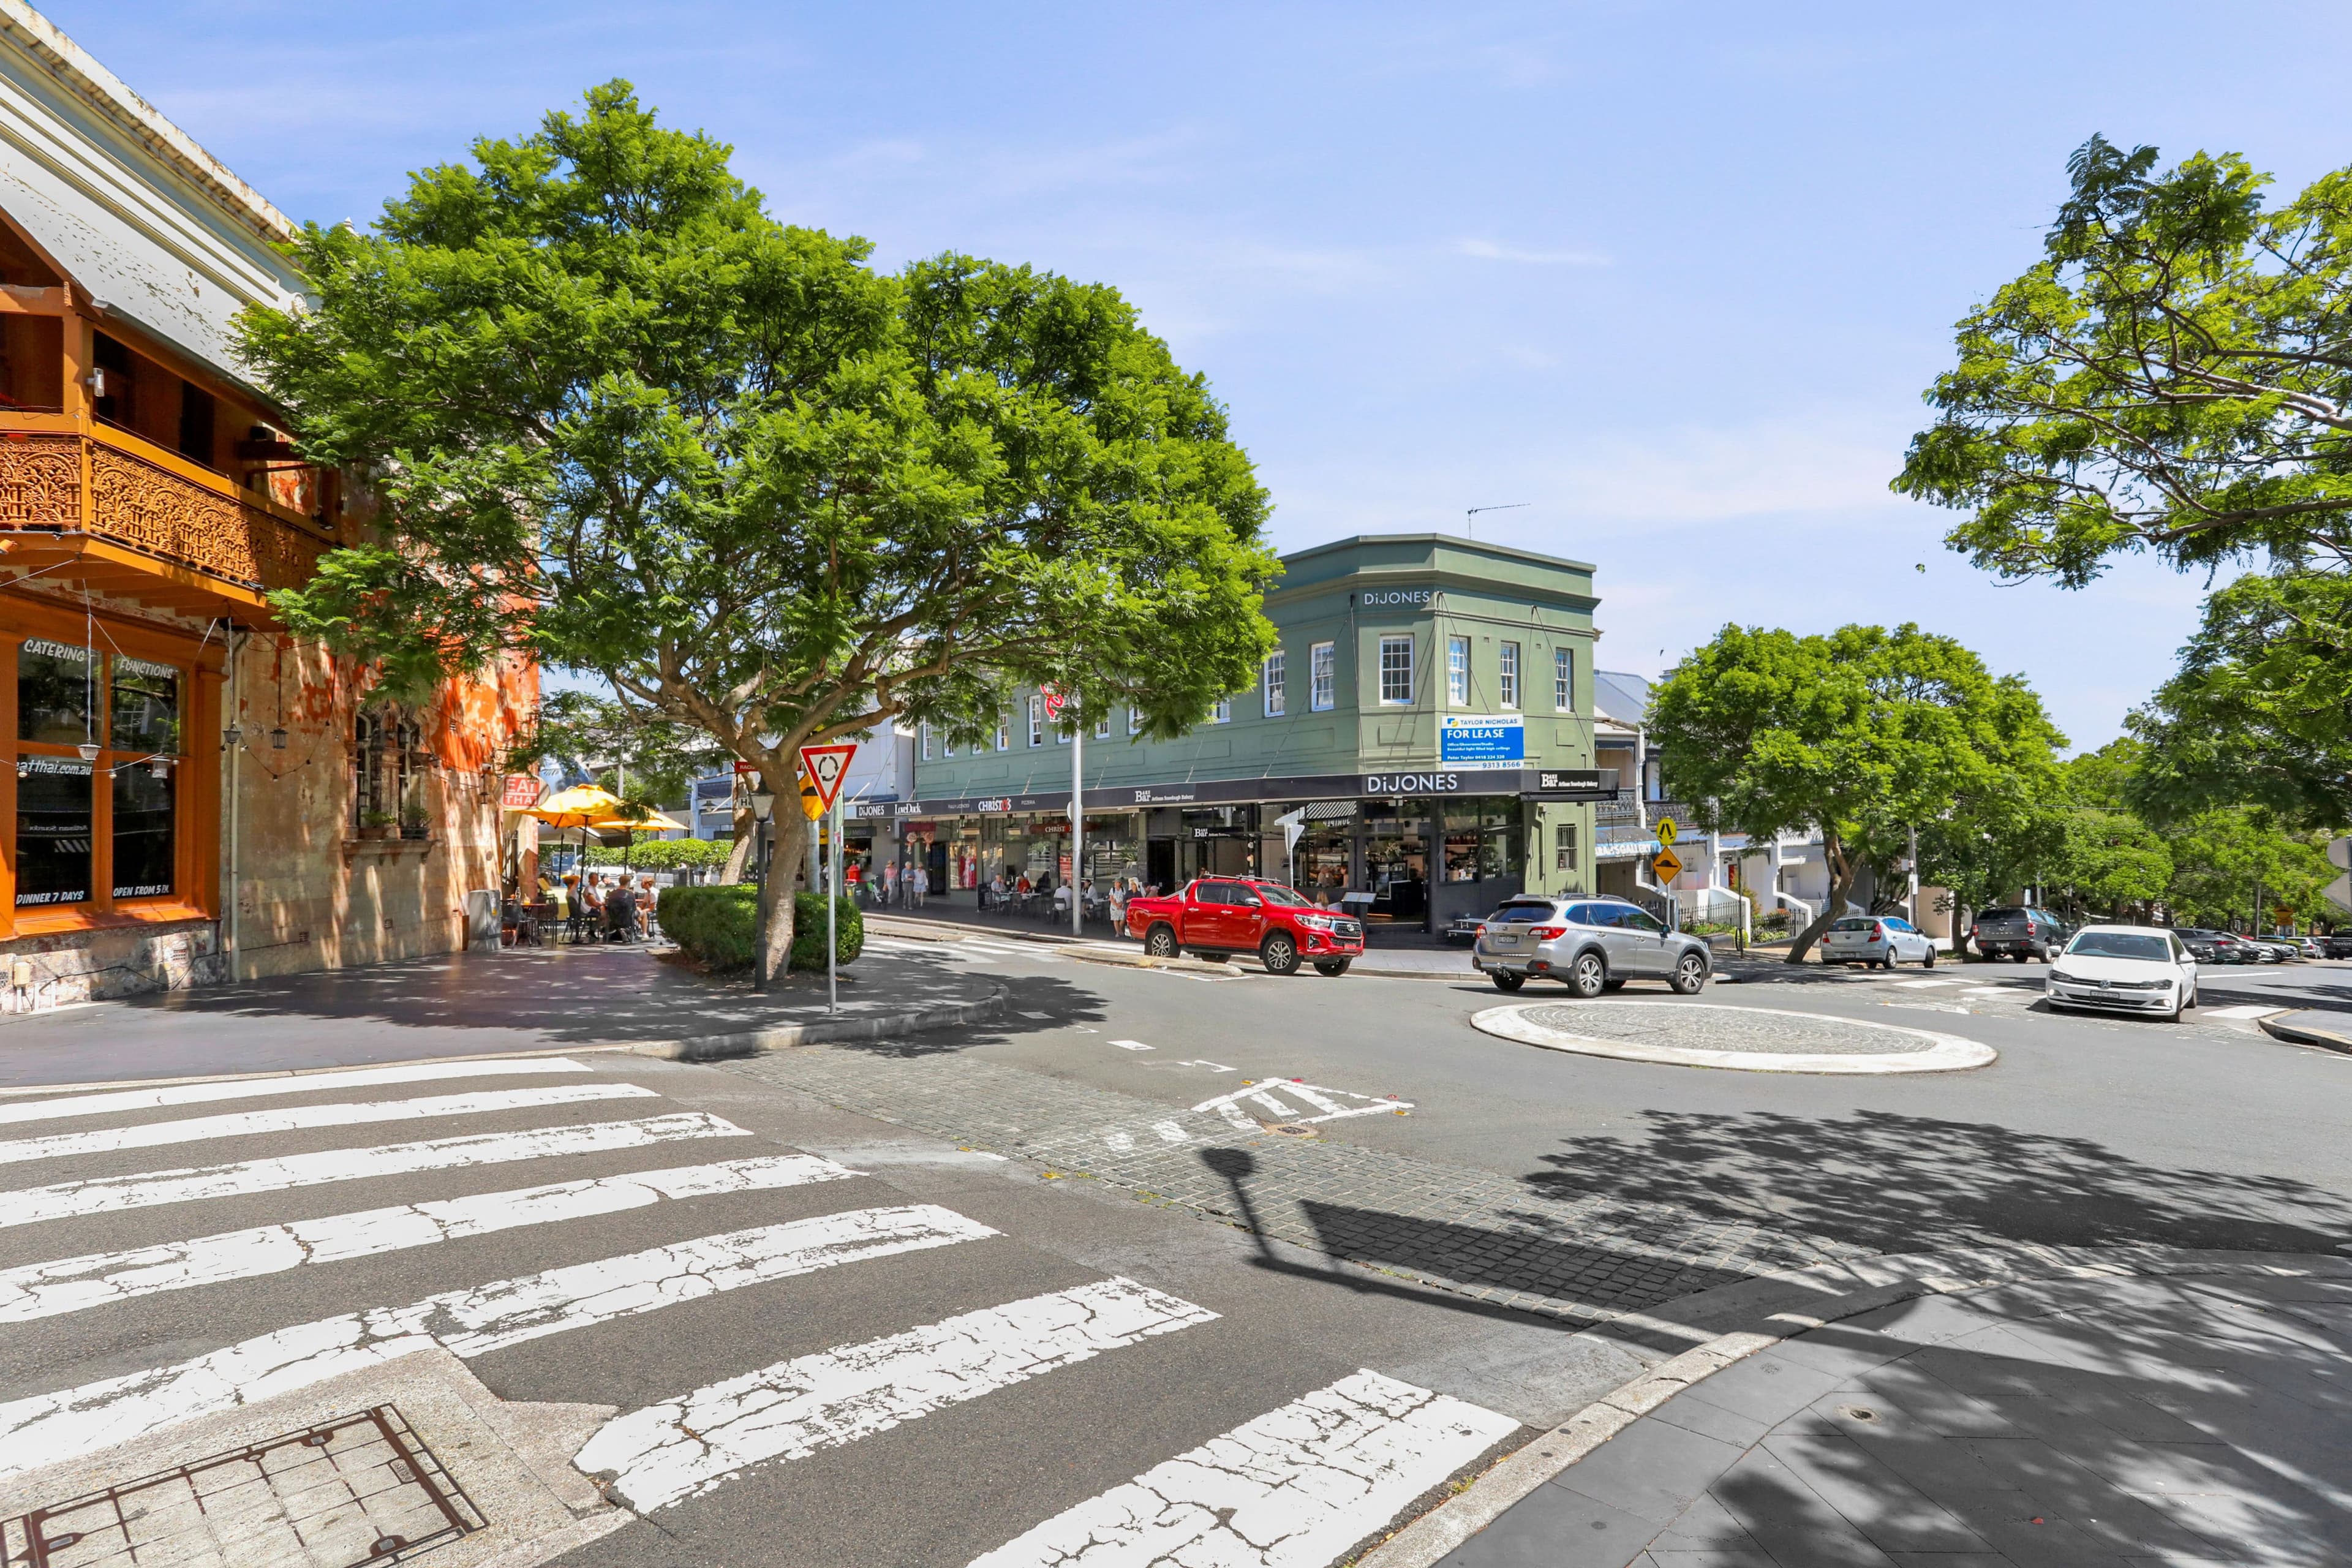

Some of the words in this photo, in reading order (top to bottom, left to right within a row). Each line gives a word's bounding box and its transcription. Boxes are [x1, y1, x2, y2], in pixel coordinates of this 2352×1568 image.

[1364, 590, 1430, 605] DiJONES
[24, 639, 85, 662] CATERING
[119, 659, 174, 680] FUNCTIONS
[1447, 729, 1470, 739] FOR
[1472, 729, 1505, 738] LEASE
[507, 778, 539, 793] EAT
[1368, 774, 1457, 792] DiJONES
[859, 805, 884, 816] DiJONES
[15, 893, 51, 905] DINNER
[52, 892, 59, 902] 7
[61, 890, 85, 901] DAYS
[113, 886, 134, 897] OPEN
[134, 886, 156, 895] FROM
